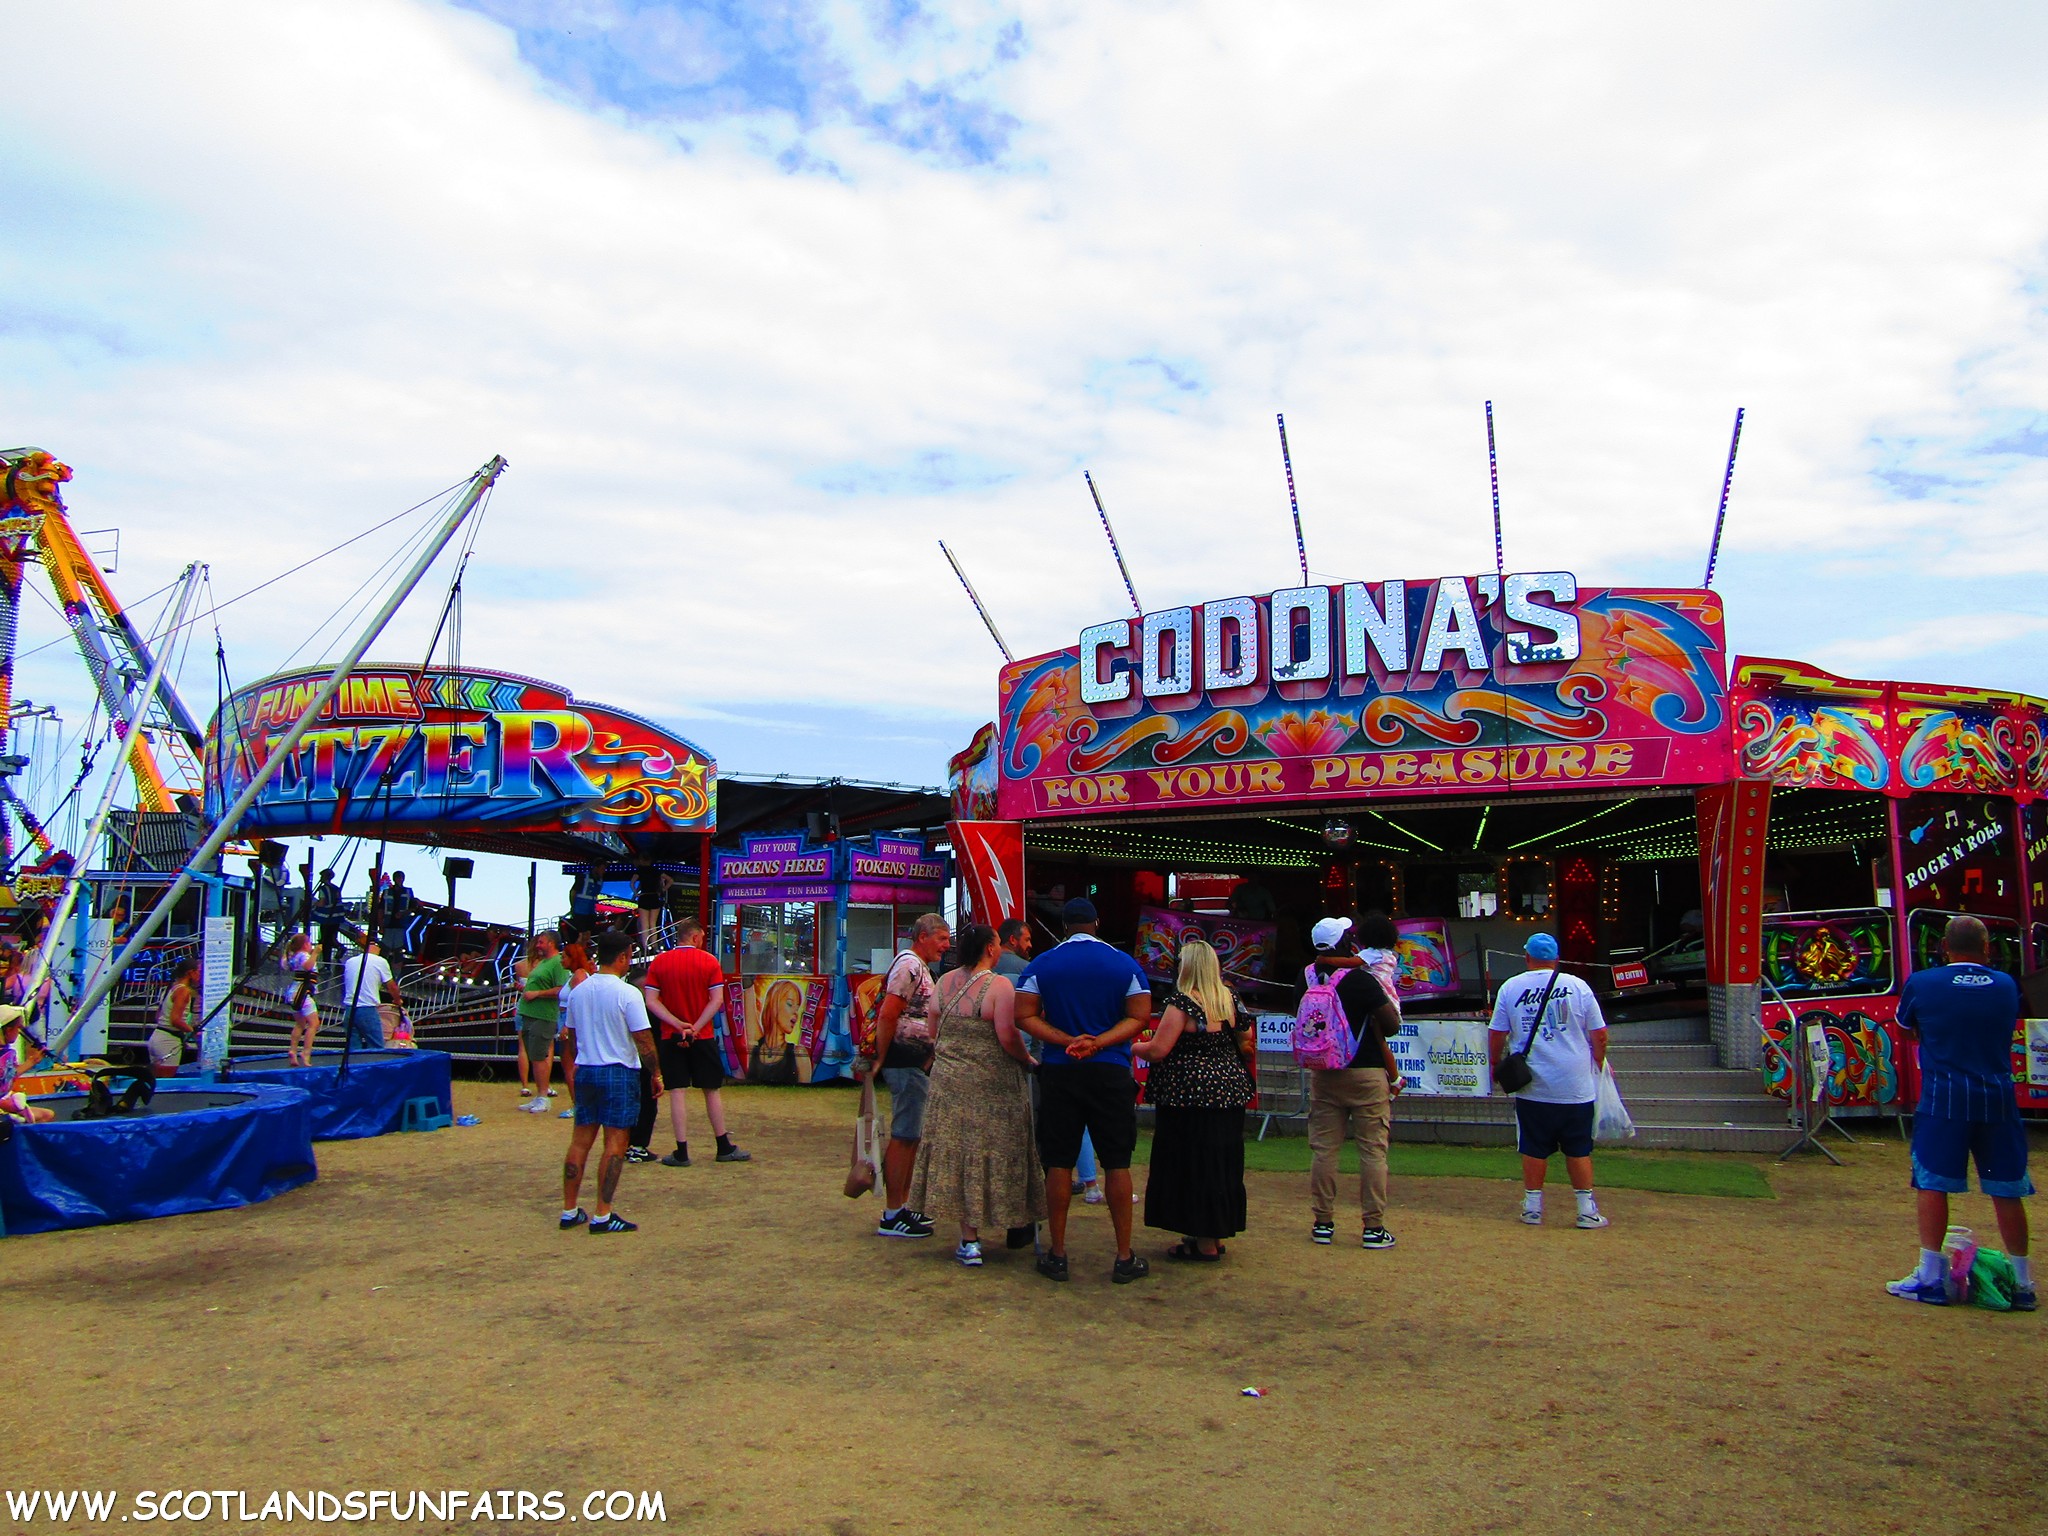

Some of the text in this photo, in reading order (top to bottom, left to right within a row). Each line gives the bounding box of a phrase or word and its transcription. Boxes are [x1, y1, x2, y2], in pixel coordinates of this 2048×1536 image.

[1080, 572, 1580, 704] CODONA'S
[1043, 742, 1634, 807] FOR YOUR PLEASURE
[752, 843, 796, 853] BUY YOUR
[883, 844, 919, 856] BUY YOUR
[2027, 835, 2048, 862] WAL
[723, 858, 826, 876] TOKENS HERE
[856, 859, 941, 878] TOKENS HERE
[728, 886, 828, 896] WHEATLEY FUN FAIRS
[1616, 969, 1643, 980] NO ENTRY
[1952, 975, 1993, 985] SEKO
[1514, 986, 1573, 1008] Adias
[728, 982, 744, 1036] PAY
[799, 982, 825, 1048] HERE
[1400, 1042, 1410, 1053] BY
[1404, 1059, 1425, 1071] FAIRS
[1427, 1051, 1487, 1065] WHEATLEY'S
